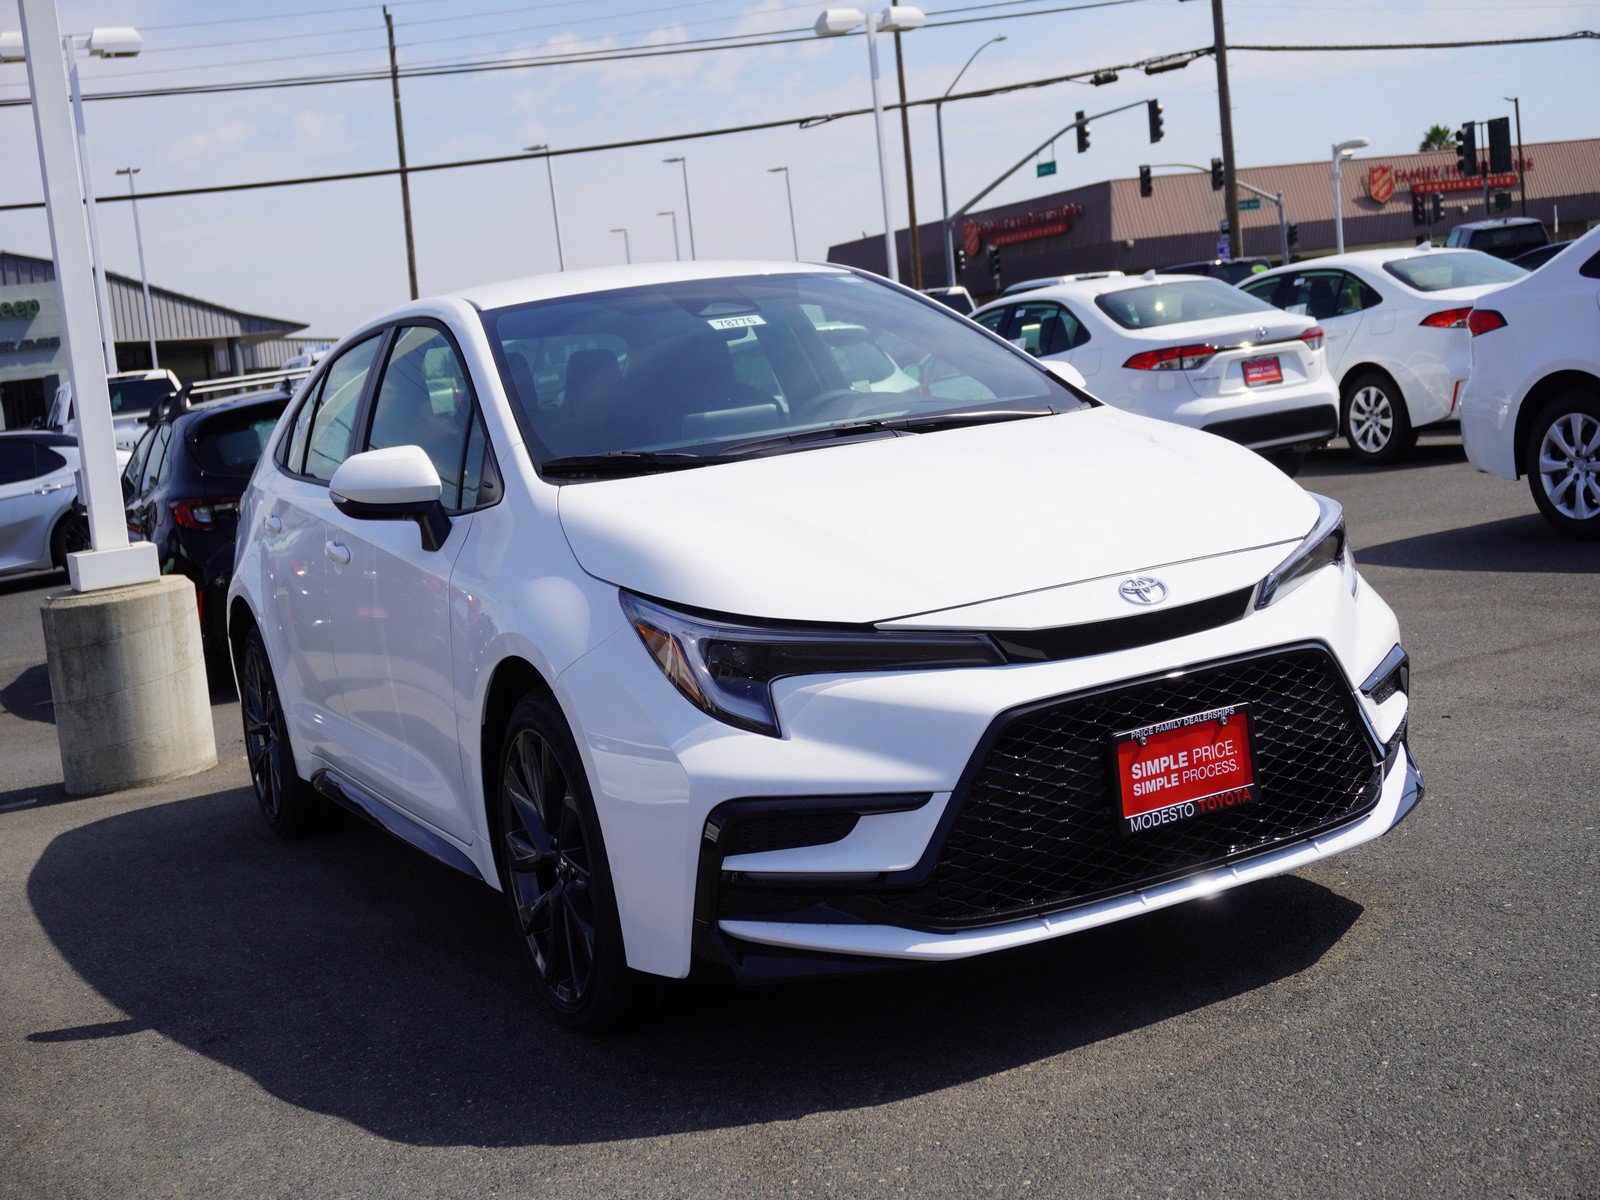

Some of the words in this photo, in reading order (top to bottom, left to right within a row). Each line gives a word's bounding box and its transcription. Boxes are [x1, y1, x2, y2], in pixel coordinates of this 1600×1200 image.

[1419, 180, 1472, 192] DONATION
[0, 299, 40, 320] eep
[1131, 728, 1154, 740] PRICE
[1155, 720, 1183, 734] FAMILY
[1183, 707, 1235, 726] DEALERSHIPS
[1131, 751, 1189, 780] SIMPLE
[1192, 739, 1238, 764] PRICE.
[1133, 773, 1180, 797] SIMPLE
[1182, 758, 1240, 784] PROCESS.
[1130, 802, 1195, 833] MODESTO
[1198, 787, 1253, 813] TOYOTA
